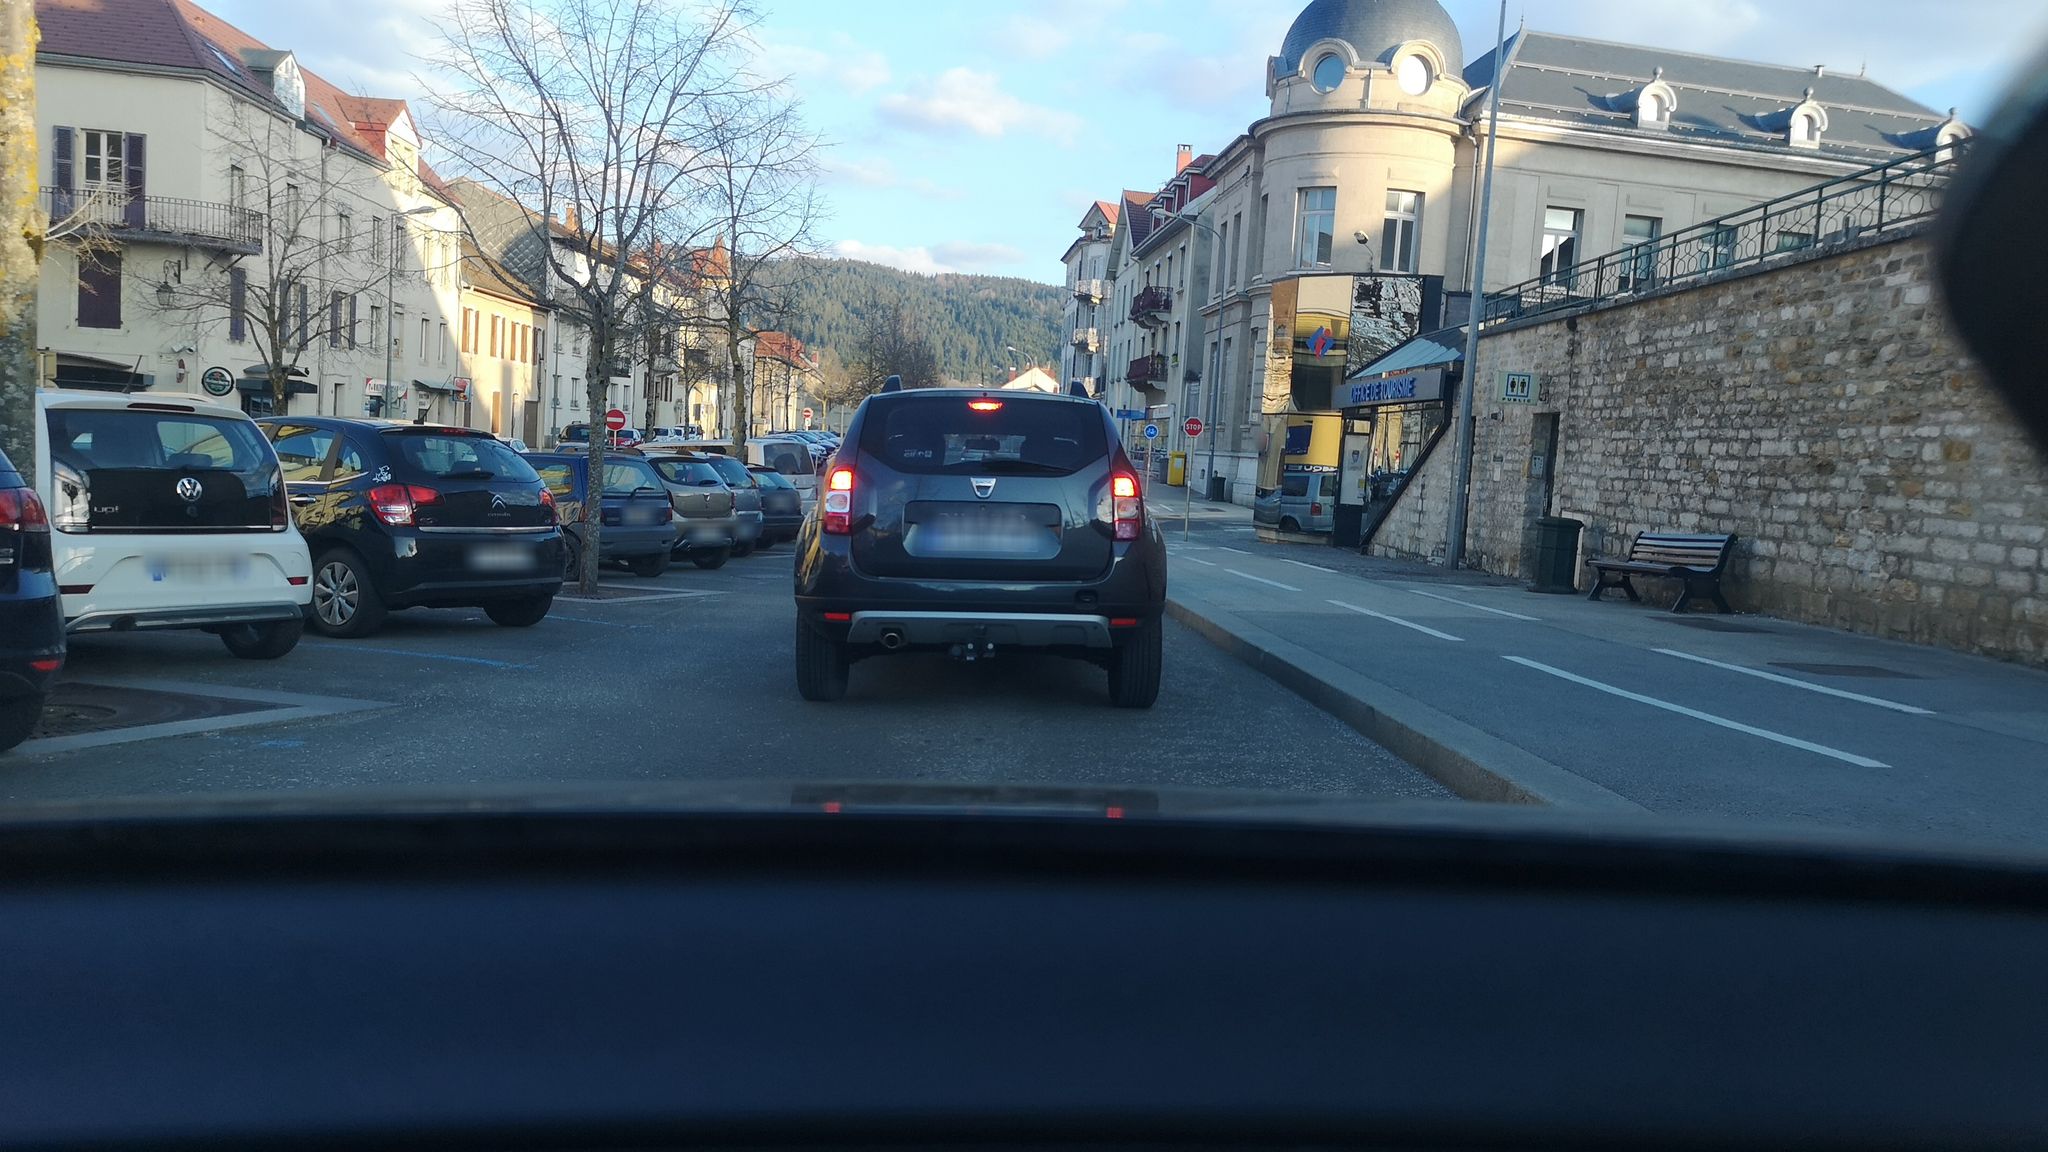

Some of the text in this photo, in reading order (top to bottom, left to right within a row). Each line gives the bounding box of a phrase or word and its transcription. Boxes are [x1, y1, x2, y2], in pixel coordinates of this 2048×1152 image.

[1351, 378, 1415, 403] OFFICE DE TOURISME
[1185, 423, 1202, 431] STOP
